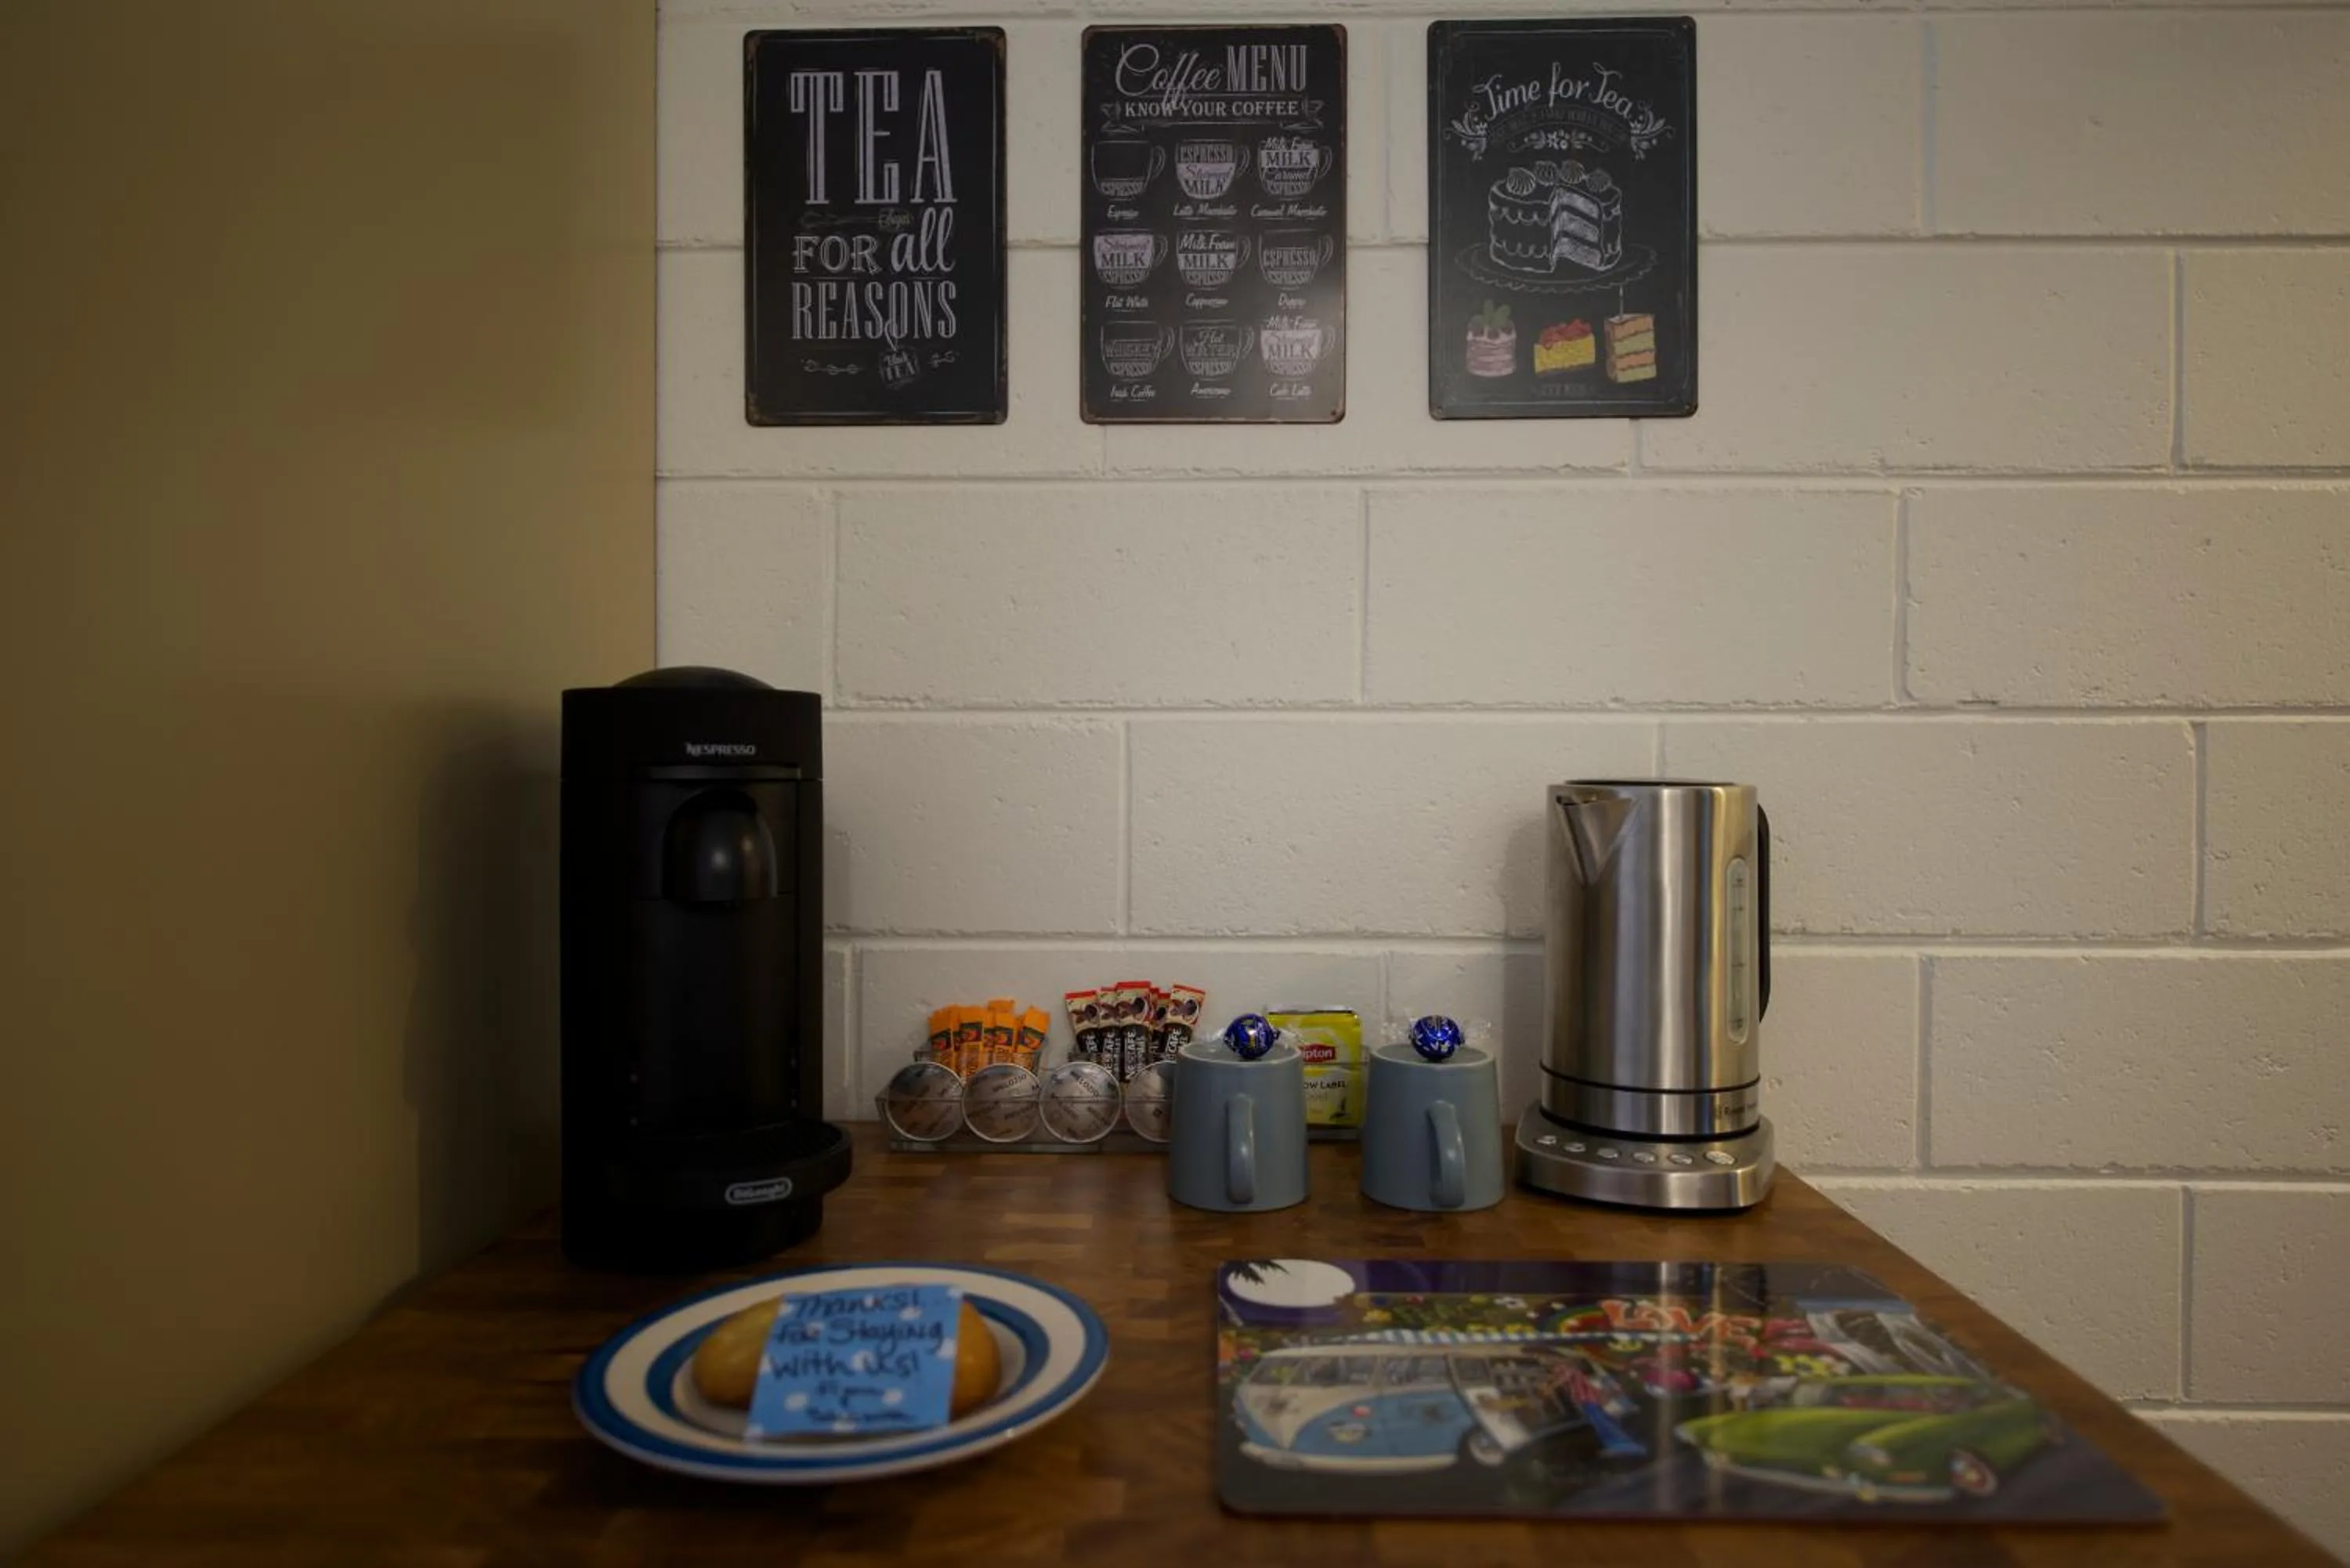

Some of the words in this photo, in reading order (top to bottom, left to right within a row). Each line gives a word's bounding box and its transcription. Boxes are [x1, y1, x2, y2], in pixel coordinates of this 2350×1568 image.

[1115, 43, 1220, 109] Coffee
[1226, 45, 1307, 92] MENU
[1472, 73, 1542, 121] Time
[1548, 62, 1589, 107] for
[1589, 62, 1632, 119] Tea
[790, 69, 958, 204] TEA
[1125, 101, 1174, 117] KNOW
[1180, 101, 1229, 117] YOUR
[1231, 100, 1299, 116] COFFEE
[1266, 151, 1311, 166] MILK
[792, 234, 883, 275] FOR
[891, 206, 957, 273] all
[1101, 252, 1145, 267] MILK
[1184, 254, 1227, 268] MILK
[790, 280, 958, 340] REASONS
